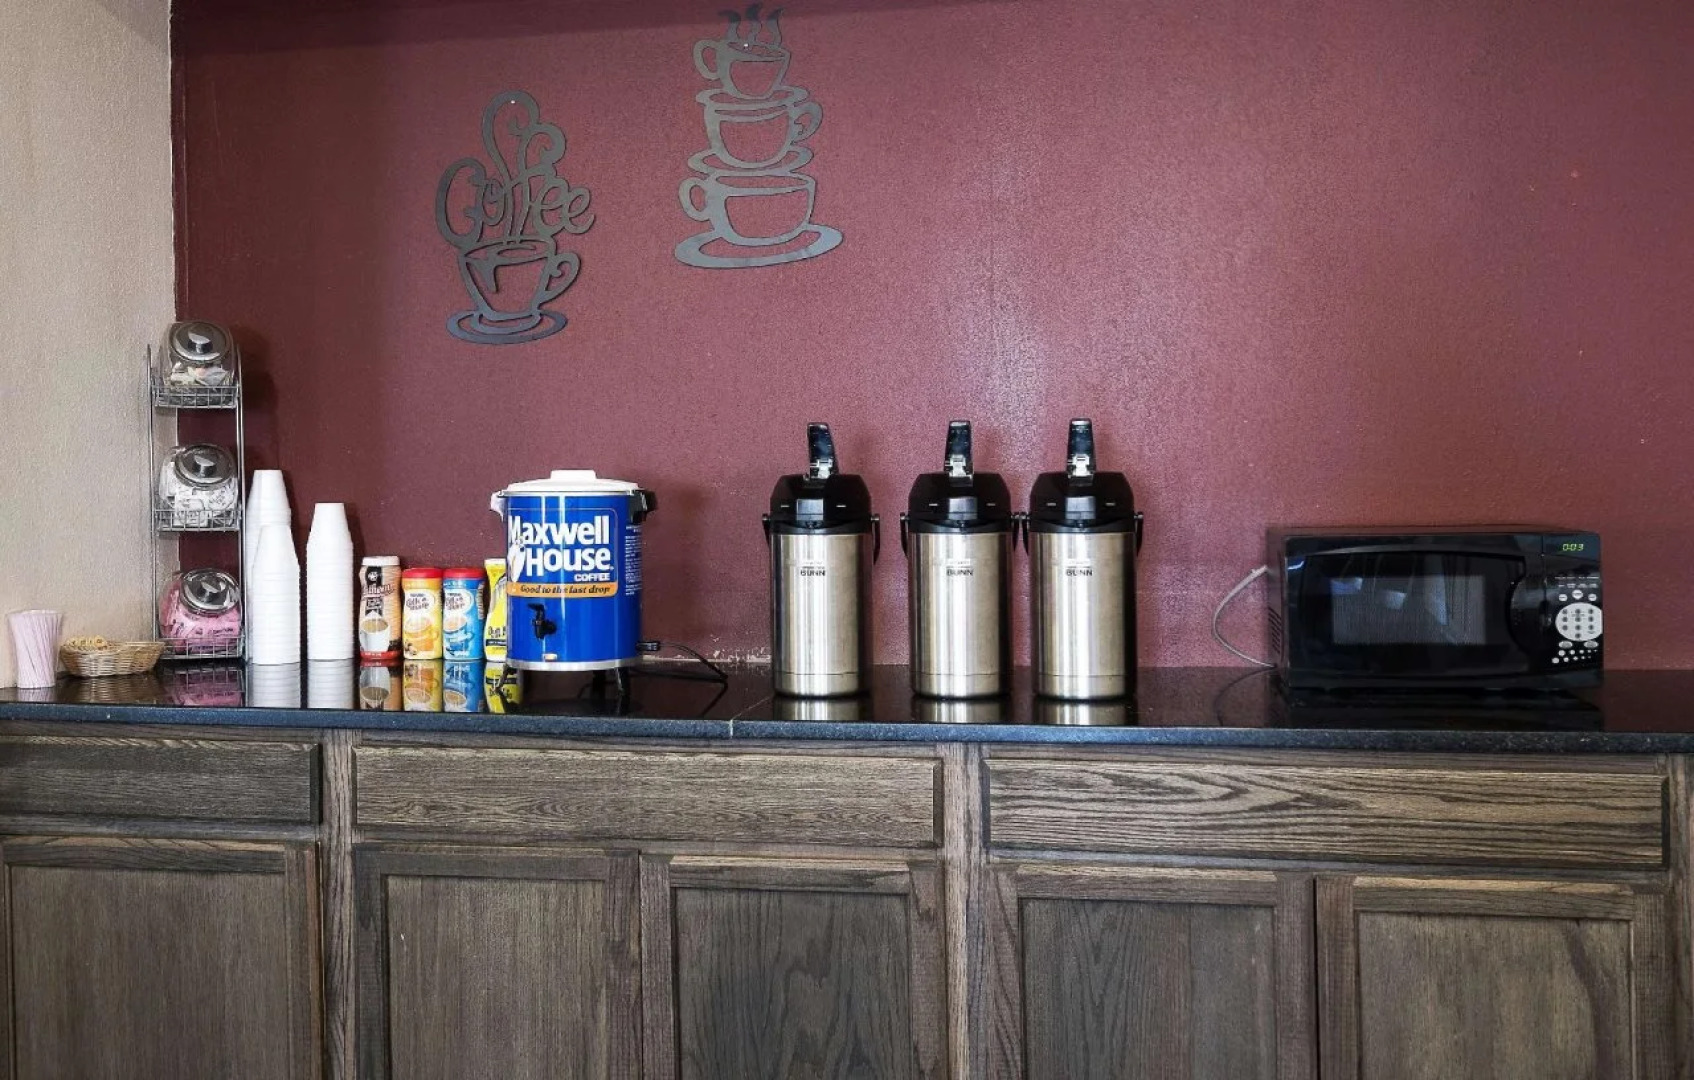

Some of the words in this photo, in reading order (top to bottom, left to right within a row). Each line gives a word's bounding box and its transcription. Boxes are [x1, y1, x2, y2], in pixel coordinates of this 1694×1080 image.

[436, 94, 596, 246] Coffee
[508, 515, 610, 545] Maxwell
[526, 547, 611, 577] House
[573, 572, 611, 582] COFFEE
[800, 569, 826, 577] BUNN
[946, 568, 973, 577] BUNN
[1066, 568, 1093, 577] BUNN
[520, 584, 542, 594] Good
[542, 585, 552, 594] to
[552, 584, 569, 594] the
[569, 584, 587, 594] last
